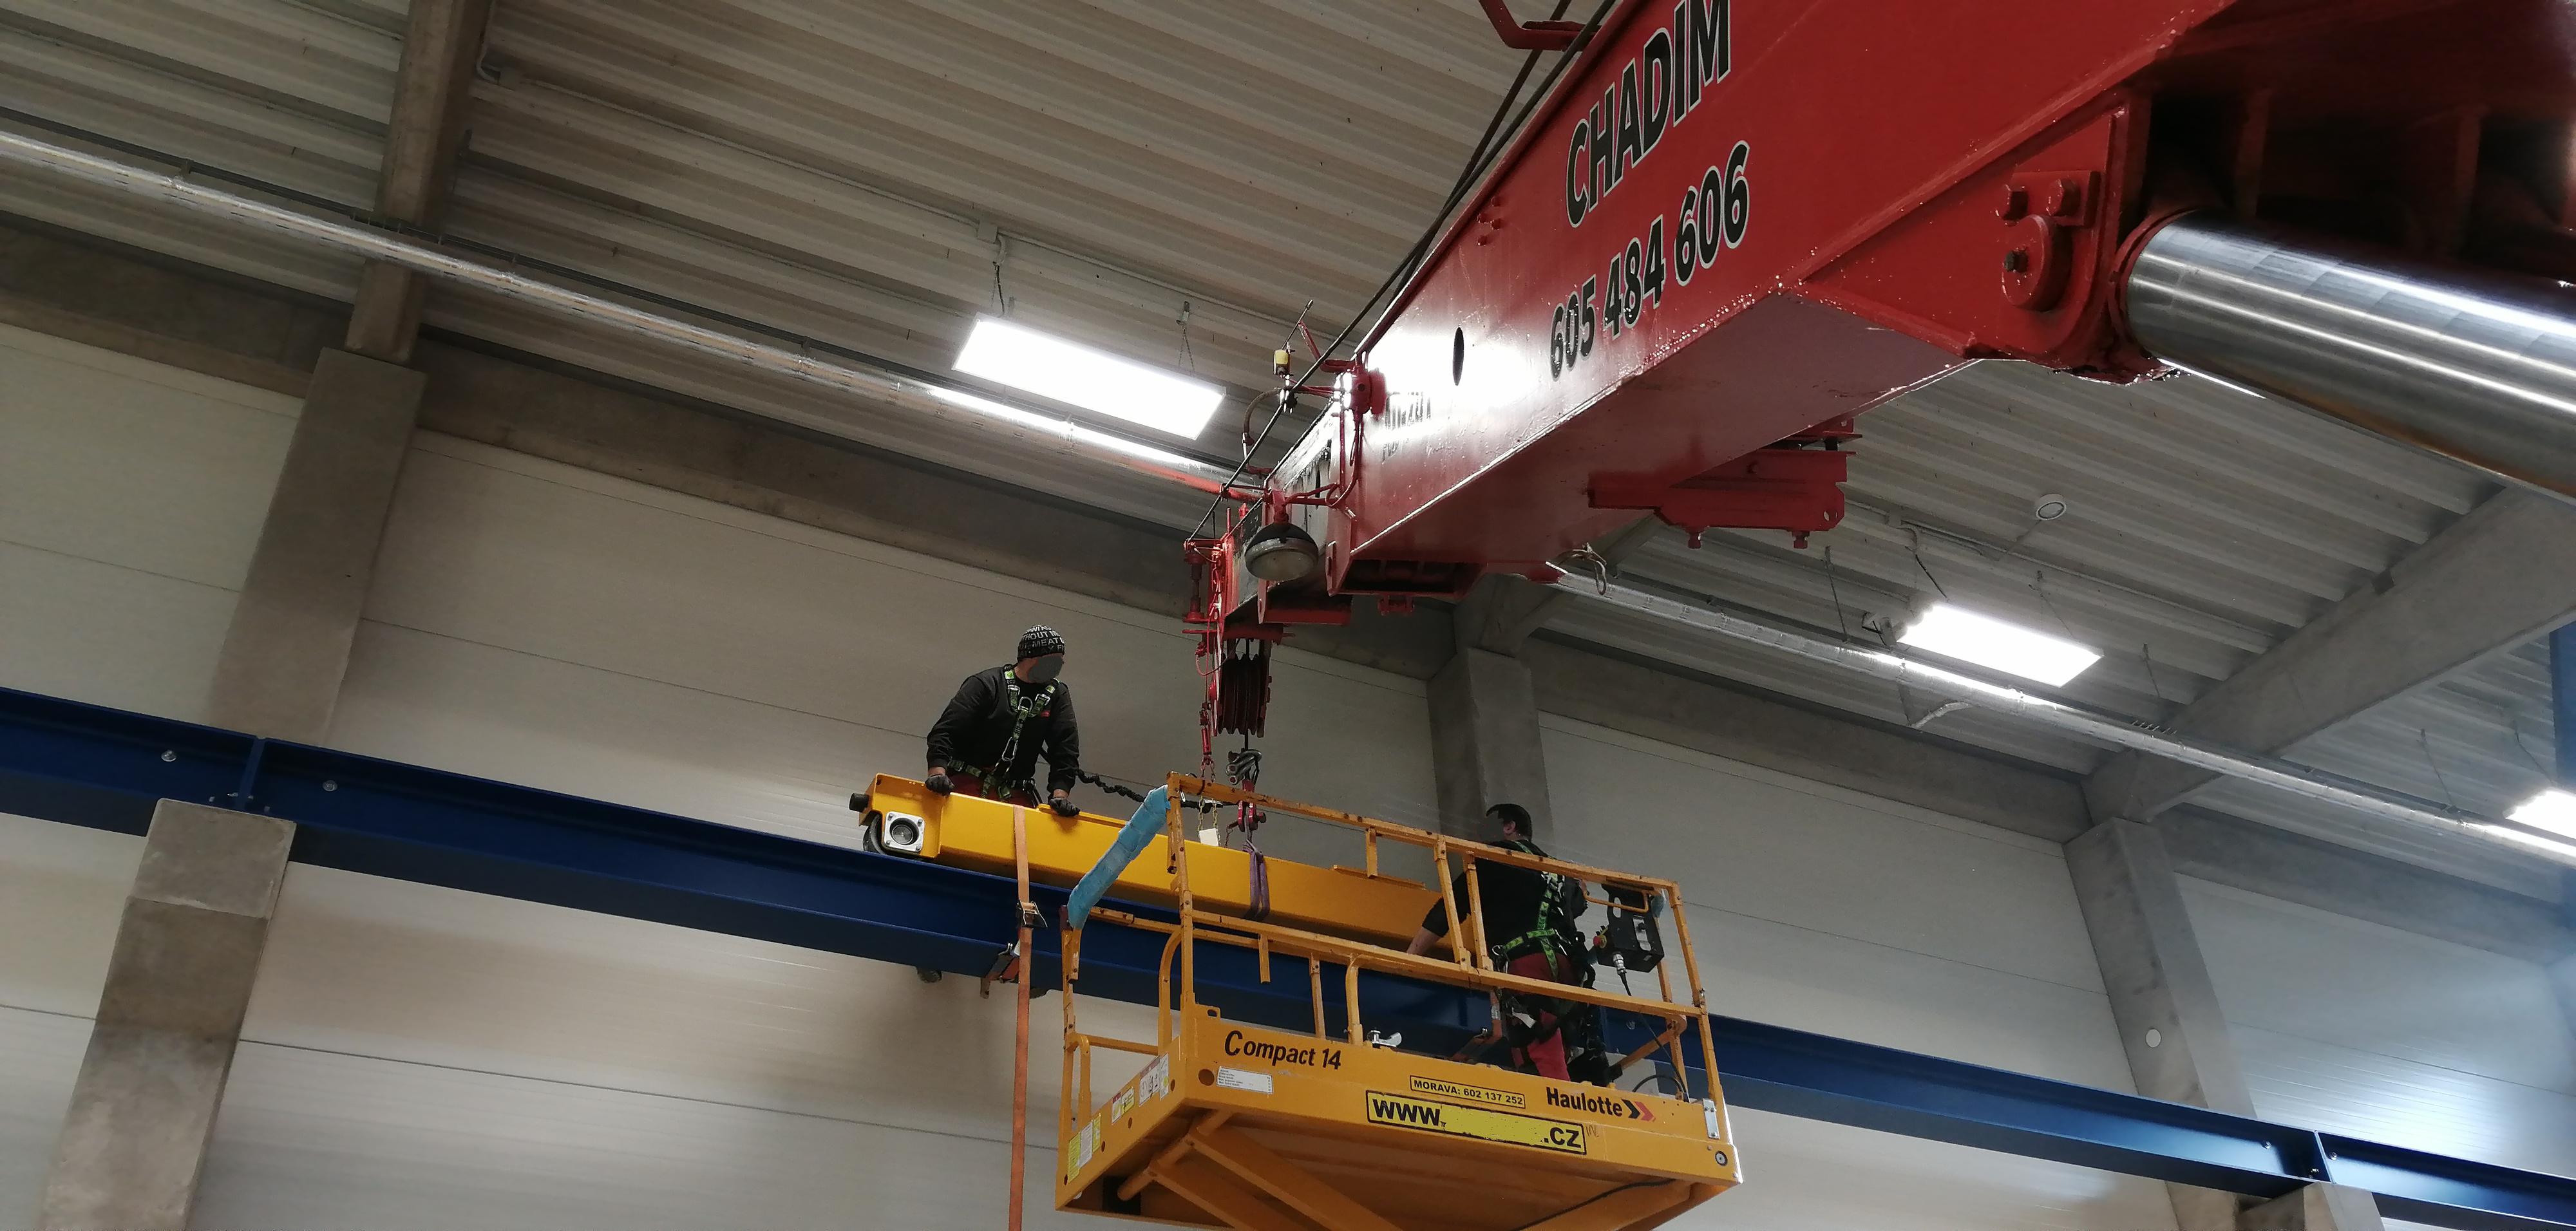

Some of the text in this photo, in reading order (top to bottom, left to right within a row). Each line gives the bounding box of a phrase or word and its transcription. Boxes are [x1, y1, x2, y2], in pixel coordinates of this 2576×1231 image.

[1566, 0, 1730, 228] CHADIM
[1551, 140, 1750, 380] 605 484 606
[1224, 1030, 1341, 1070] Compact 14
[1414, 1080, 1523, 1105] MORAVA: 602 137 252
[1546, 1086, 1623, 1117] Haulotte
